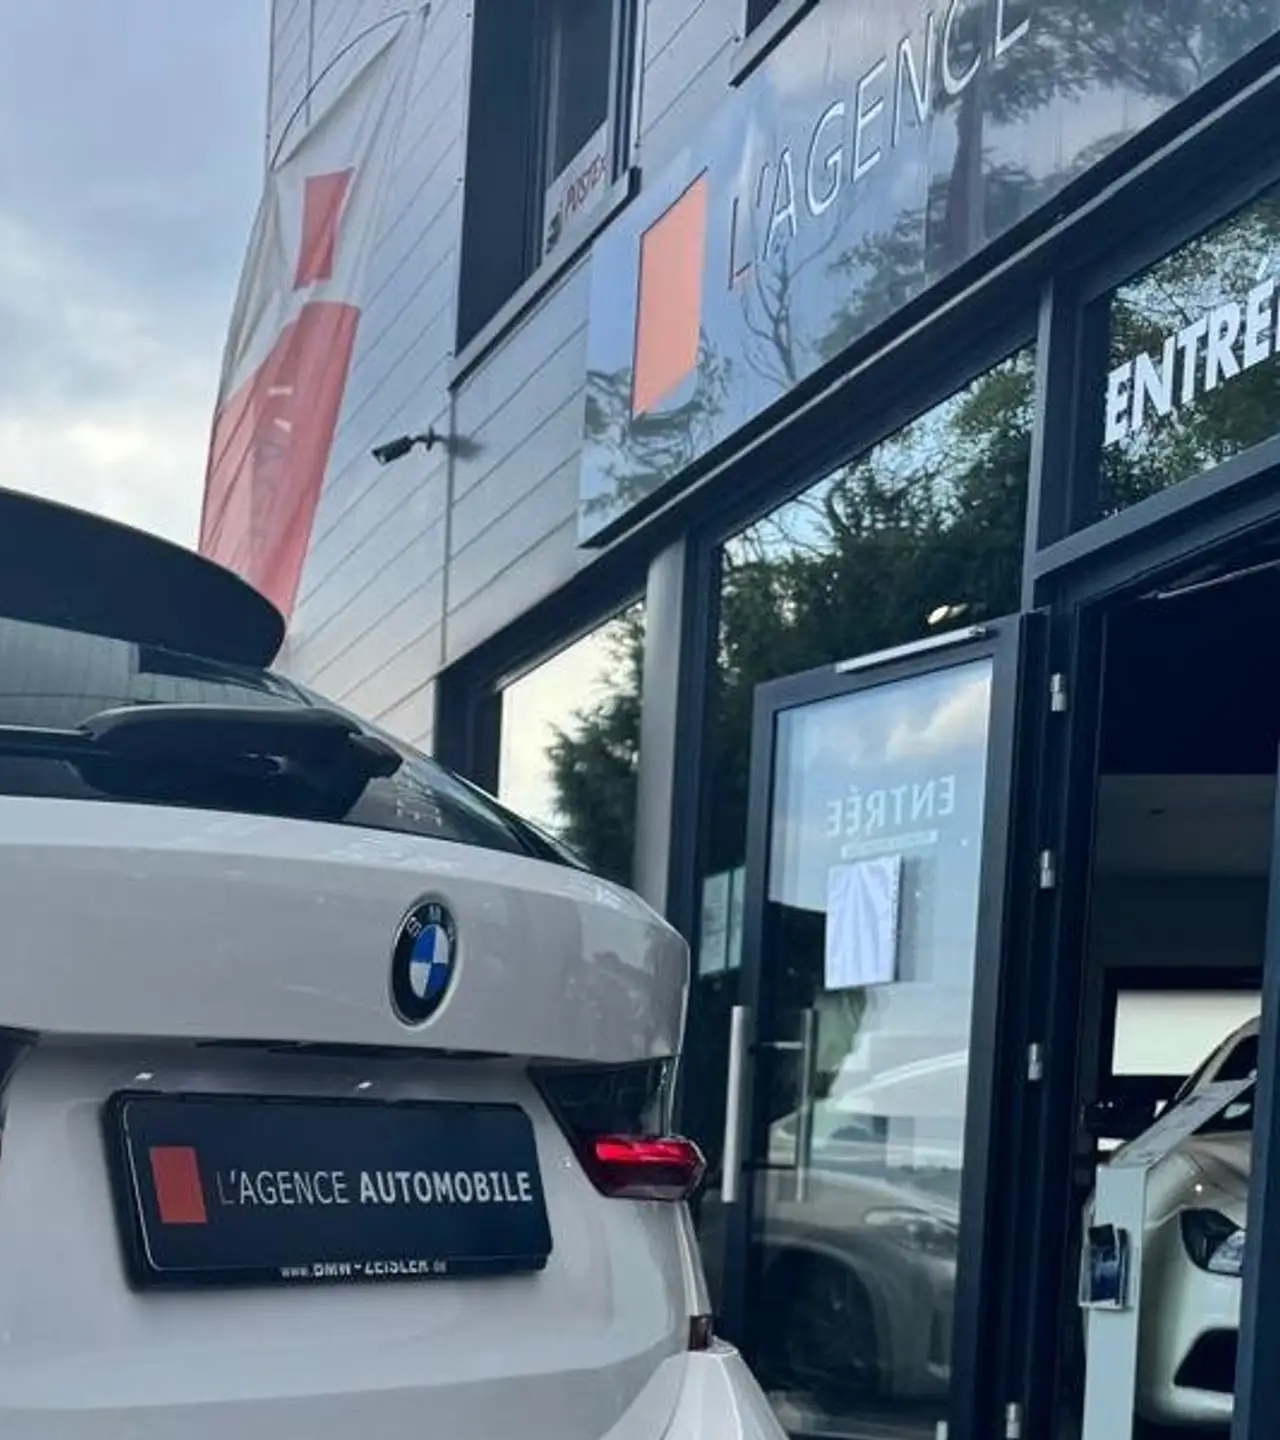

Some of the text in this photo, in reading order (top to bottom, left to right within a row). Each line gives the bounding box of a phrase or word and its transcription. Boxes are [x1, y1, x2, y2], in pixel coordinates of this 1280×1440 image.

[1104, 256, 1280, 446] ENTRÉ
[216, 1170, 533, 1206] L'AGENCE AUTOMOBILE
